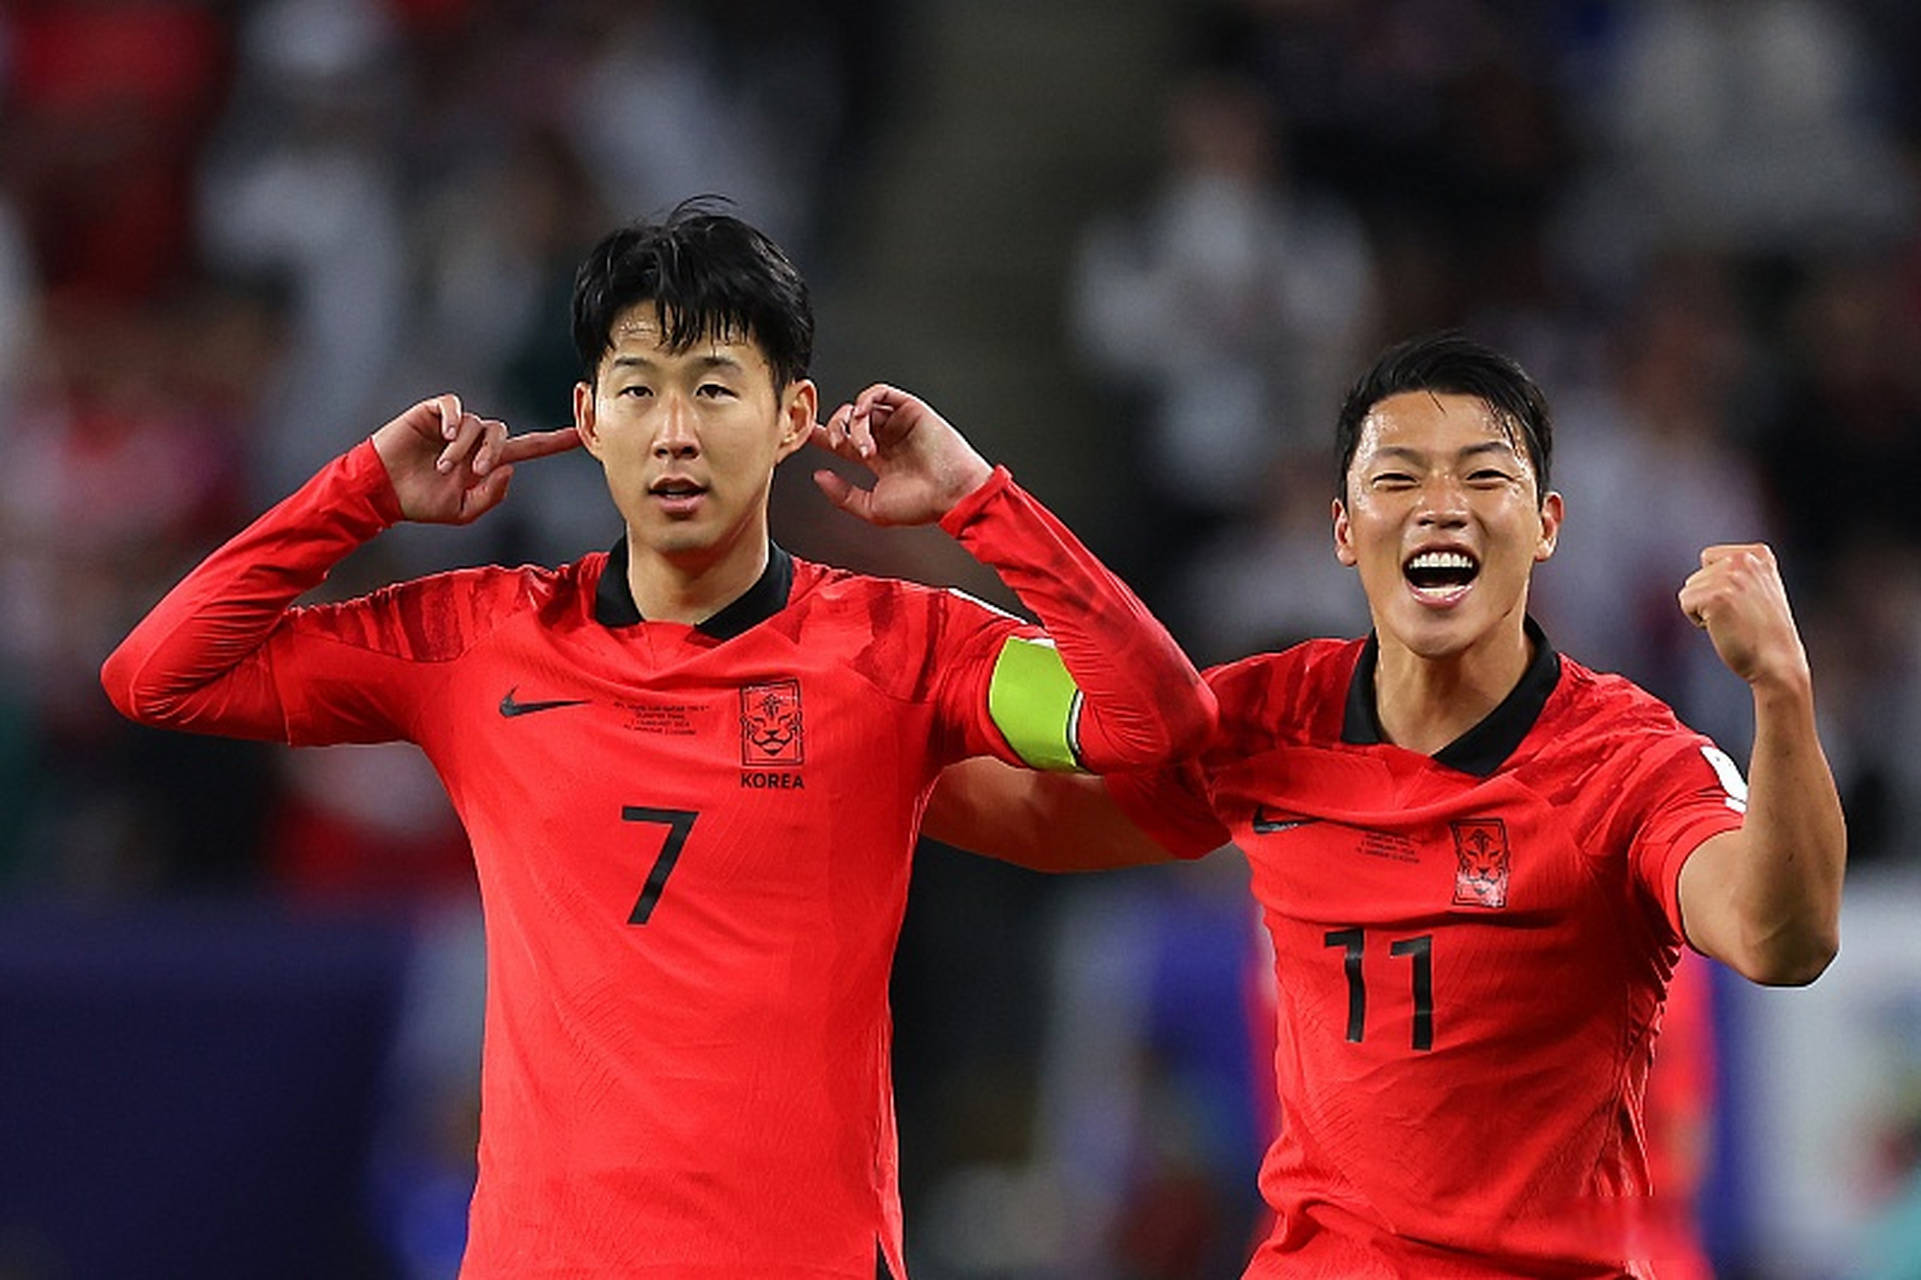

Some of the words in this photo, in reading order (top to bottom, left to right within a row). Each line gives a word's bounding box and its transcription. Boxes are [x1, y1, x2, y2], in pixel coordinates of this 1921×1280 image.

[740, 772, 805, 789] KOREA
[622, 805, 700, 925] 7
[1324, 927, 1434, 1052] 11
